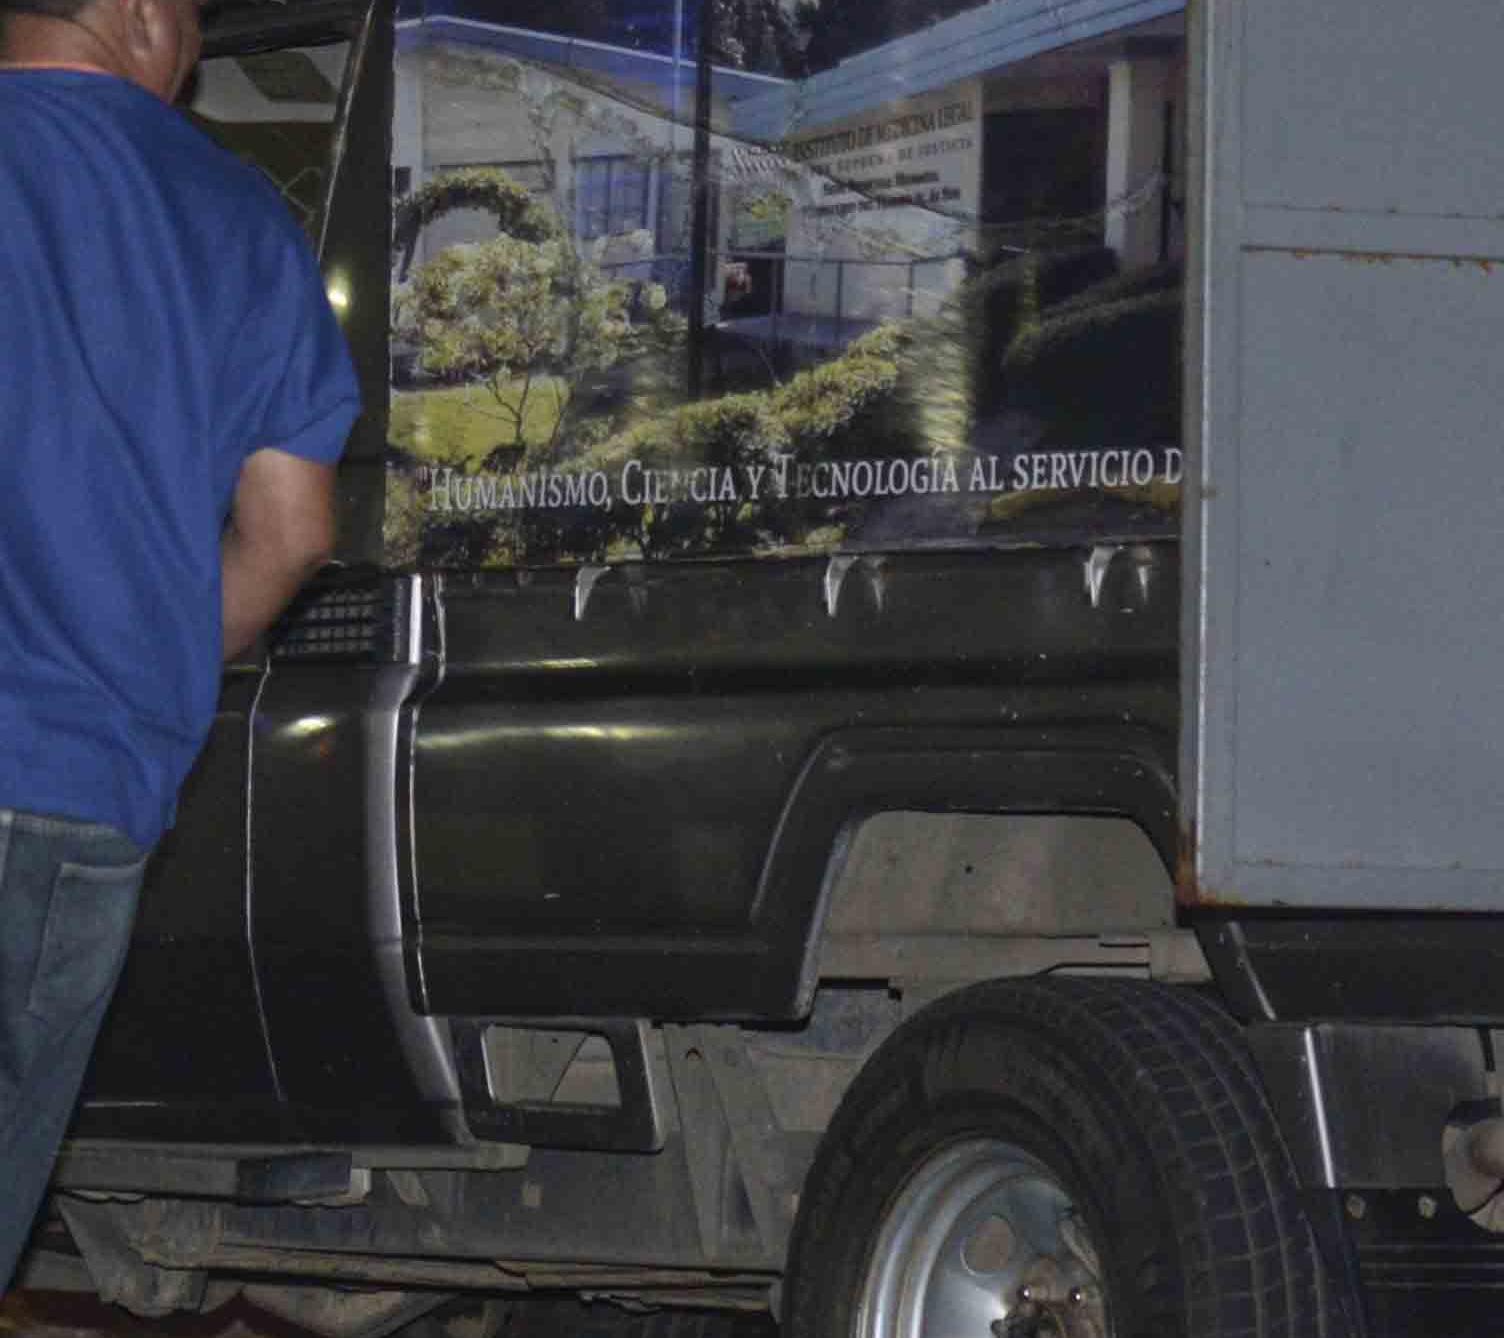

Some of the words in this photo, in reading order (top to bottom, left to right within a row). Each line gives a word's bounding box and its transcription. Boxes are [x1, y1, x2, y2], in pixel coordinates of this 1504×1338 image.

[622, 459, 737, 505] CIENCIA
[746, 464, 767, 501] Y
[969, 455, 1003, 492] AL
[1012, 448, 1155, 491] SERVICIO
